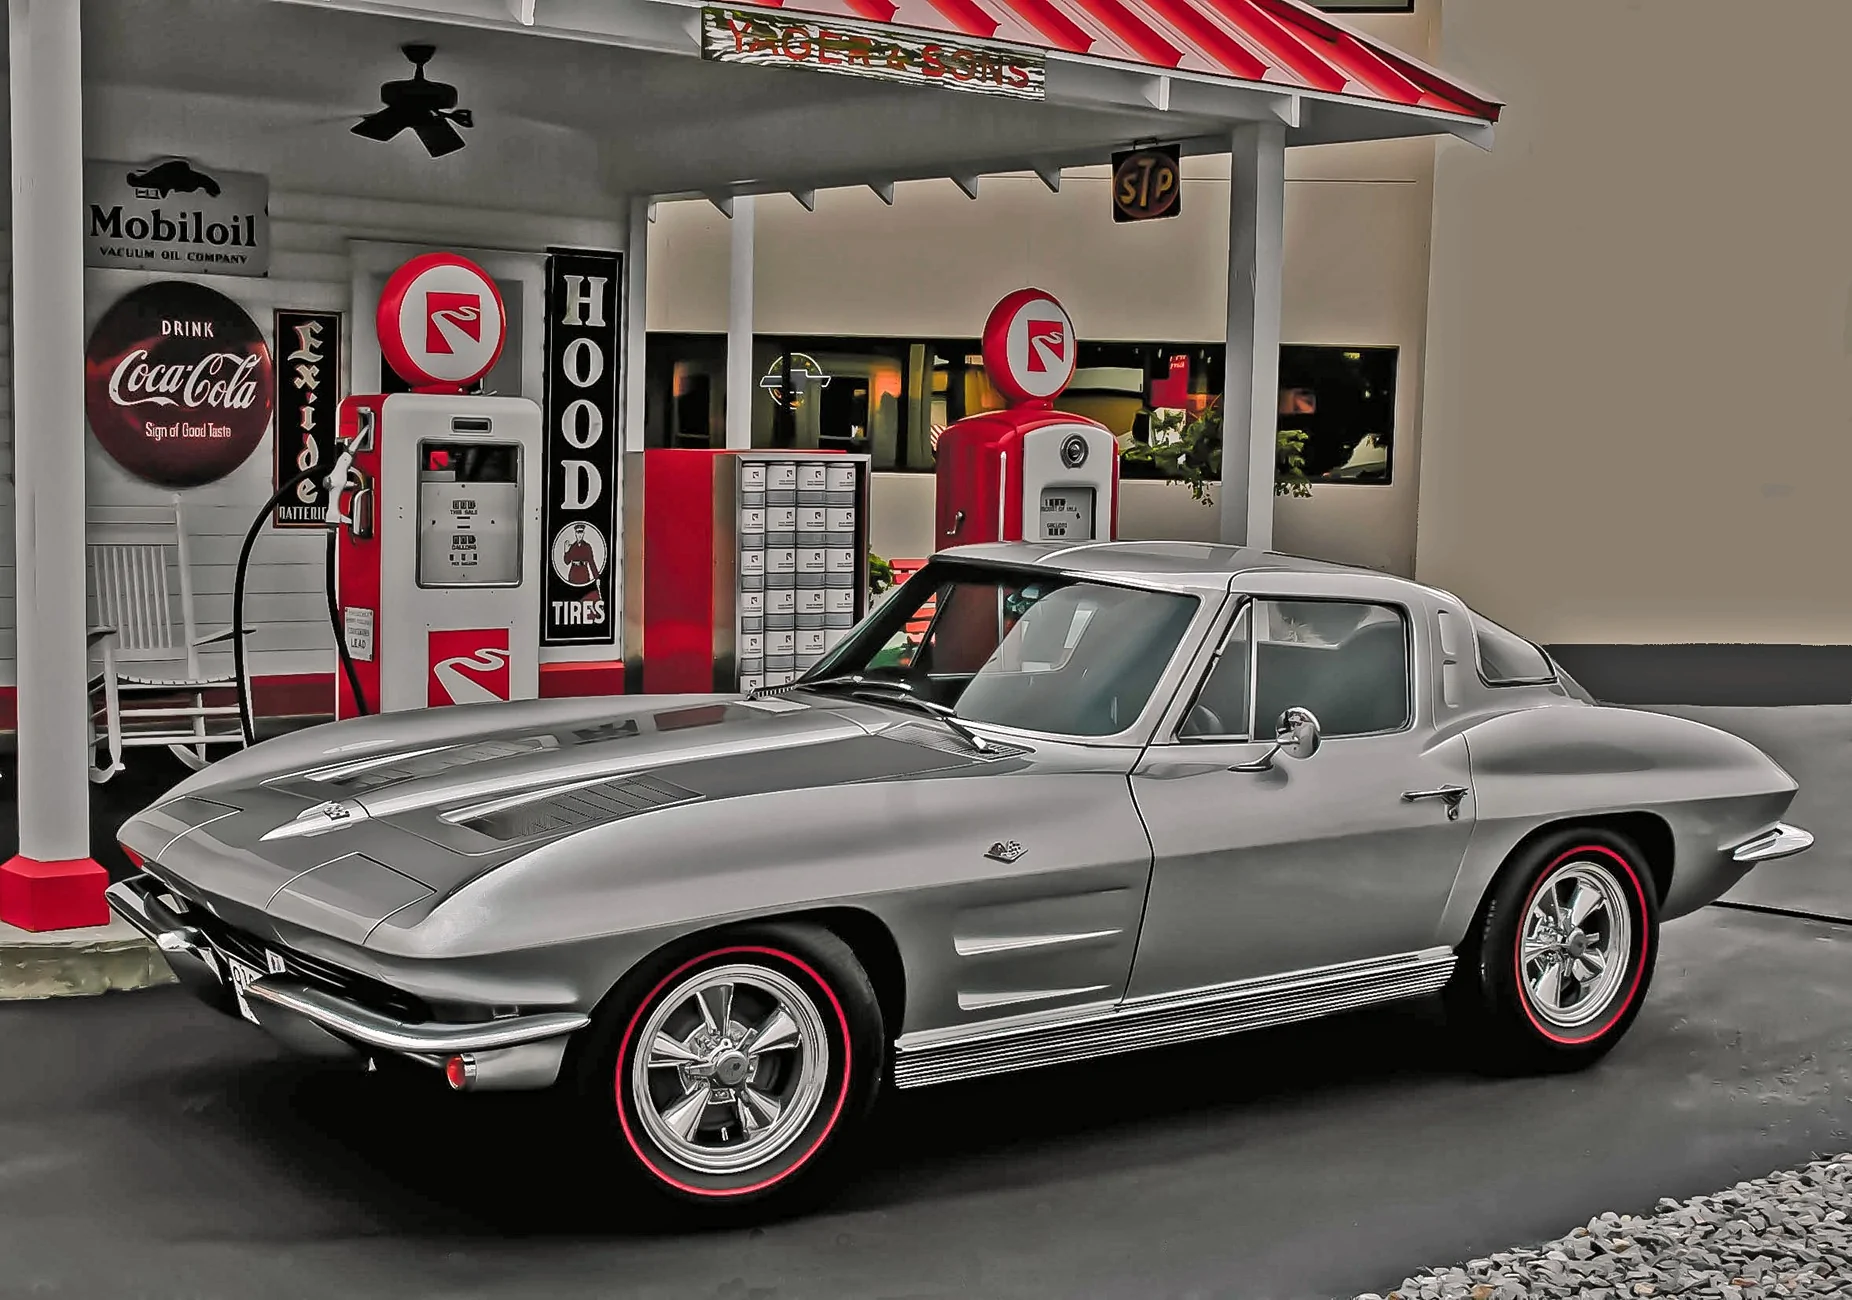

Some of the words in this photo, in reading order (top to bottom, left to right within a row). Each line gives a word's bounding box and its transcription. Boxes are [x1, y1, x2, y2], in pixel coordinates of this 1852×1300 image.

[727, 19, 872, 67] YAGER
[886, 44, 907, 71] &
[920, 44, 1030, 88] SONS
[1120, 158, 1173, 207] STP
[89, 204, 258, 247] Mobiloil
[100, 246, 155, 259] VACUUM
[161, 250, 181, 261] OIL
[187, 251, 248, 264] COMPANY
[161, 320, 214, 338] DRINK
[108, 349, 262, 409] Coca-Cola
[561, 275, 608, 510] HOOD
[287, 320, 324, 504] Exide
[145, 421, 168, 441] Sign
[169, 422, 179, 438] of
[182, 423, 206, 438] Good
[209, 423, 232, 438] Taste
[279, 506, 327, 520] BATTERIE
[552, 600, 606, 625] TIRES
[350, 637, 367, 649] LEAD
